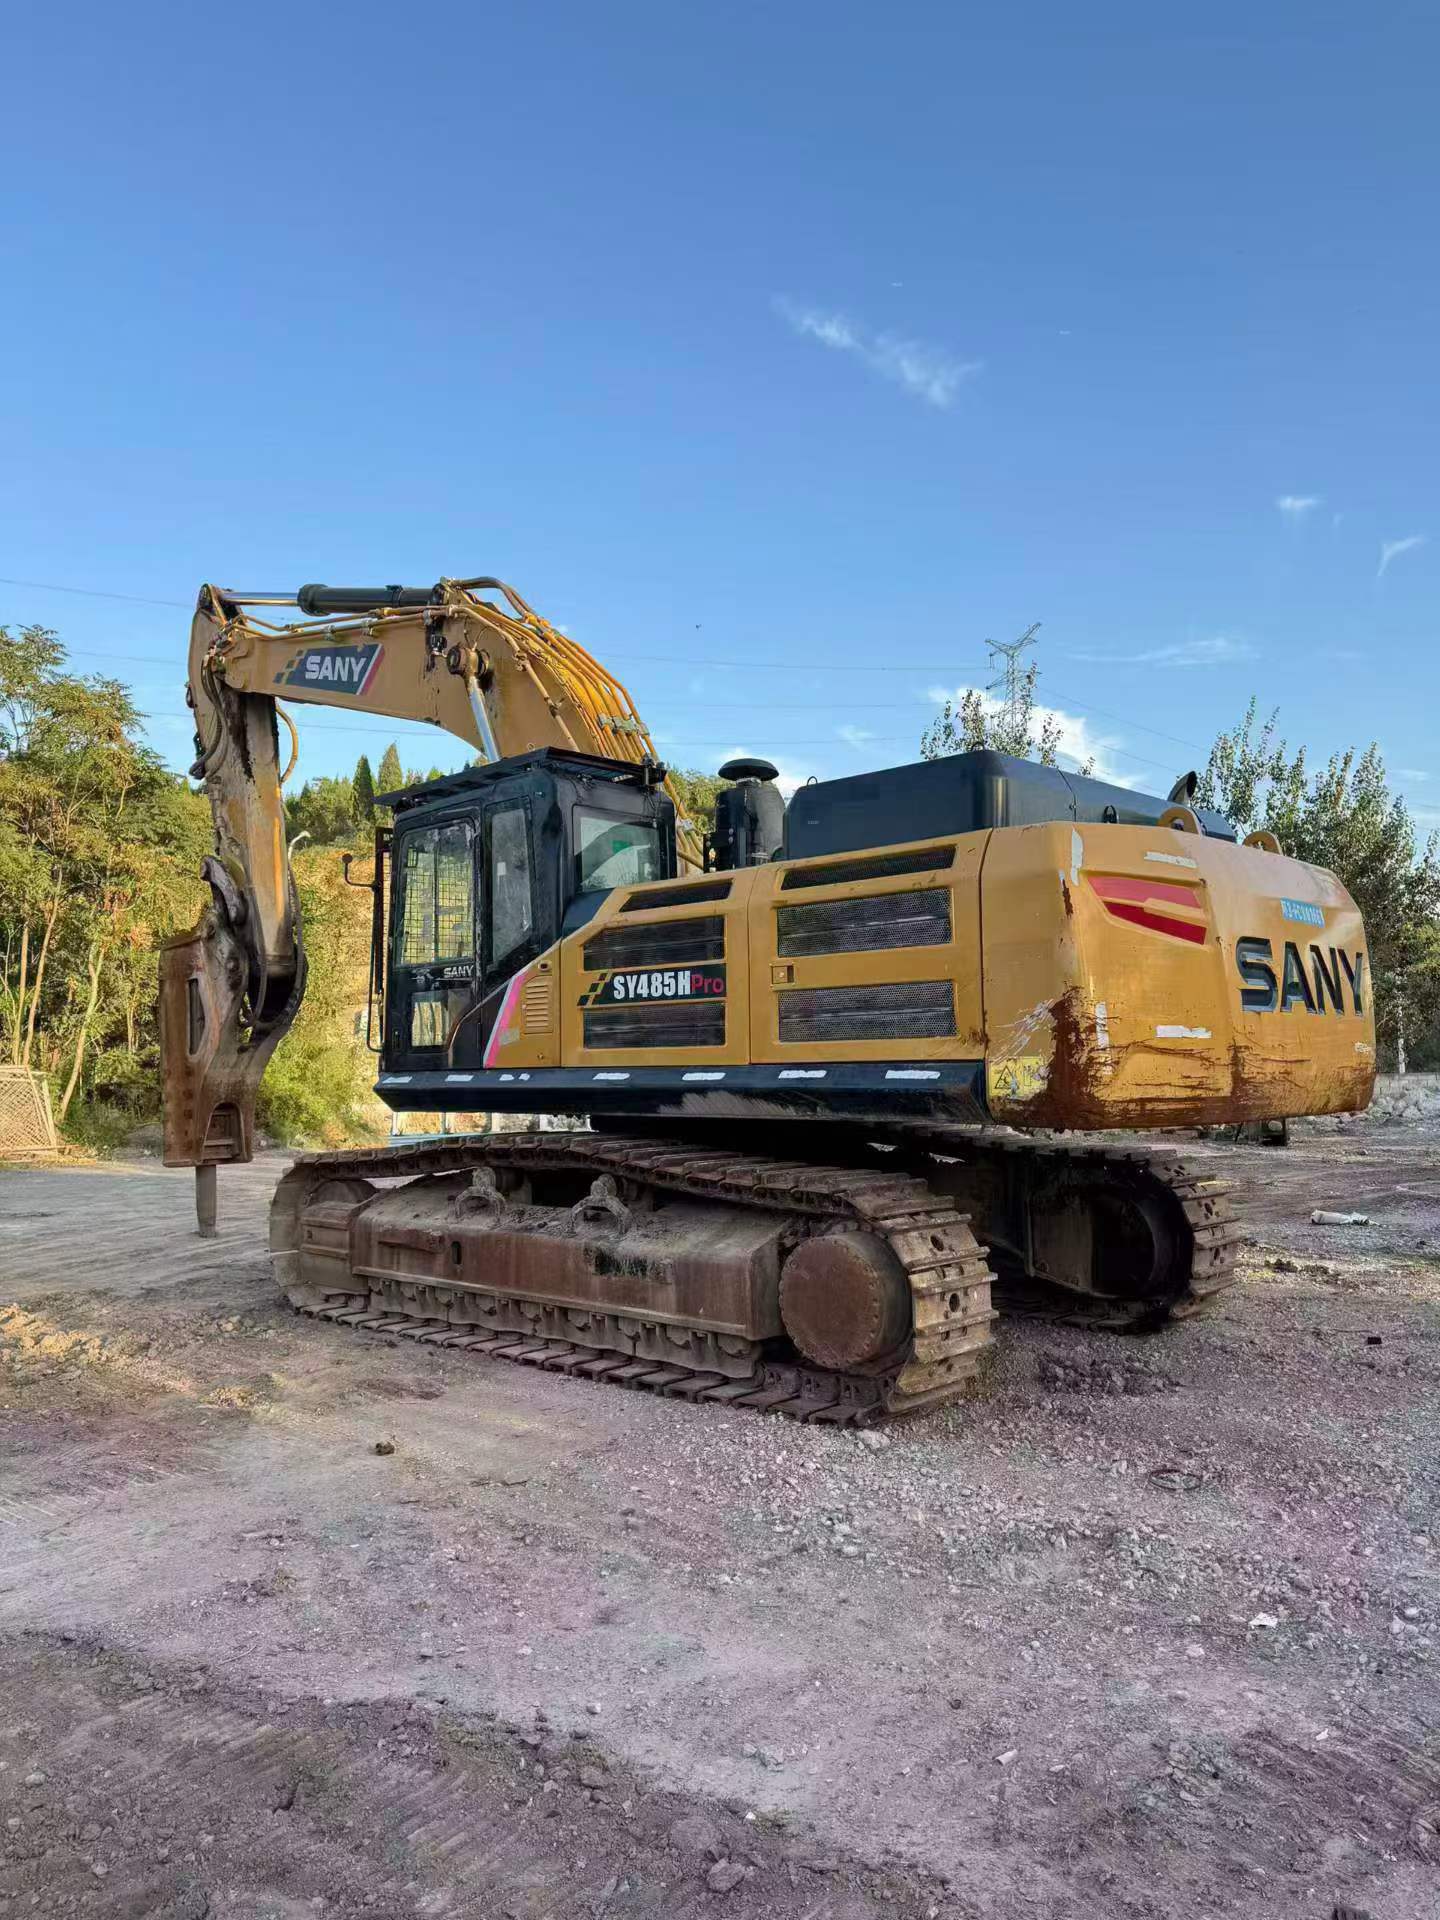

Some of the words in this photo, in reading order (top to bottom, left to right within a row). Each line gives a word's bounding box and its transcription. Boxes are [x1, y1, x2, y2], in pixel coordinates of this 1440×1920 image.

[305, 655, 367, 682] SANY
[443, 964, 474, 978] SANY
[1235, 935, 1363, 1017] SANY
